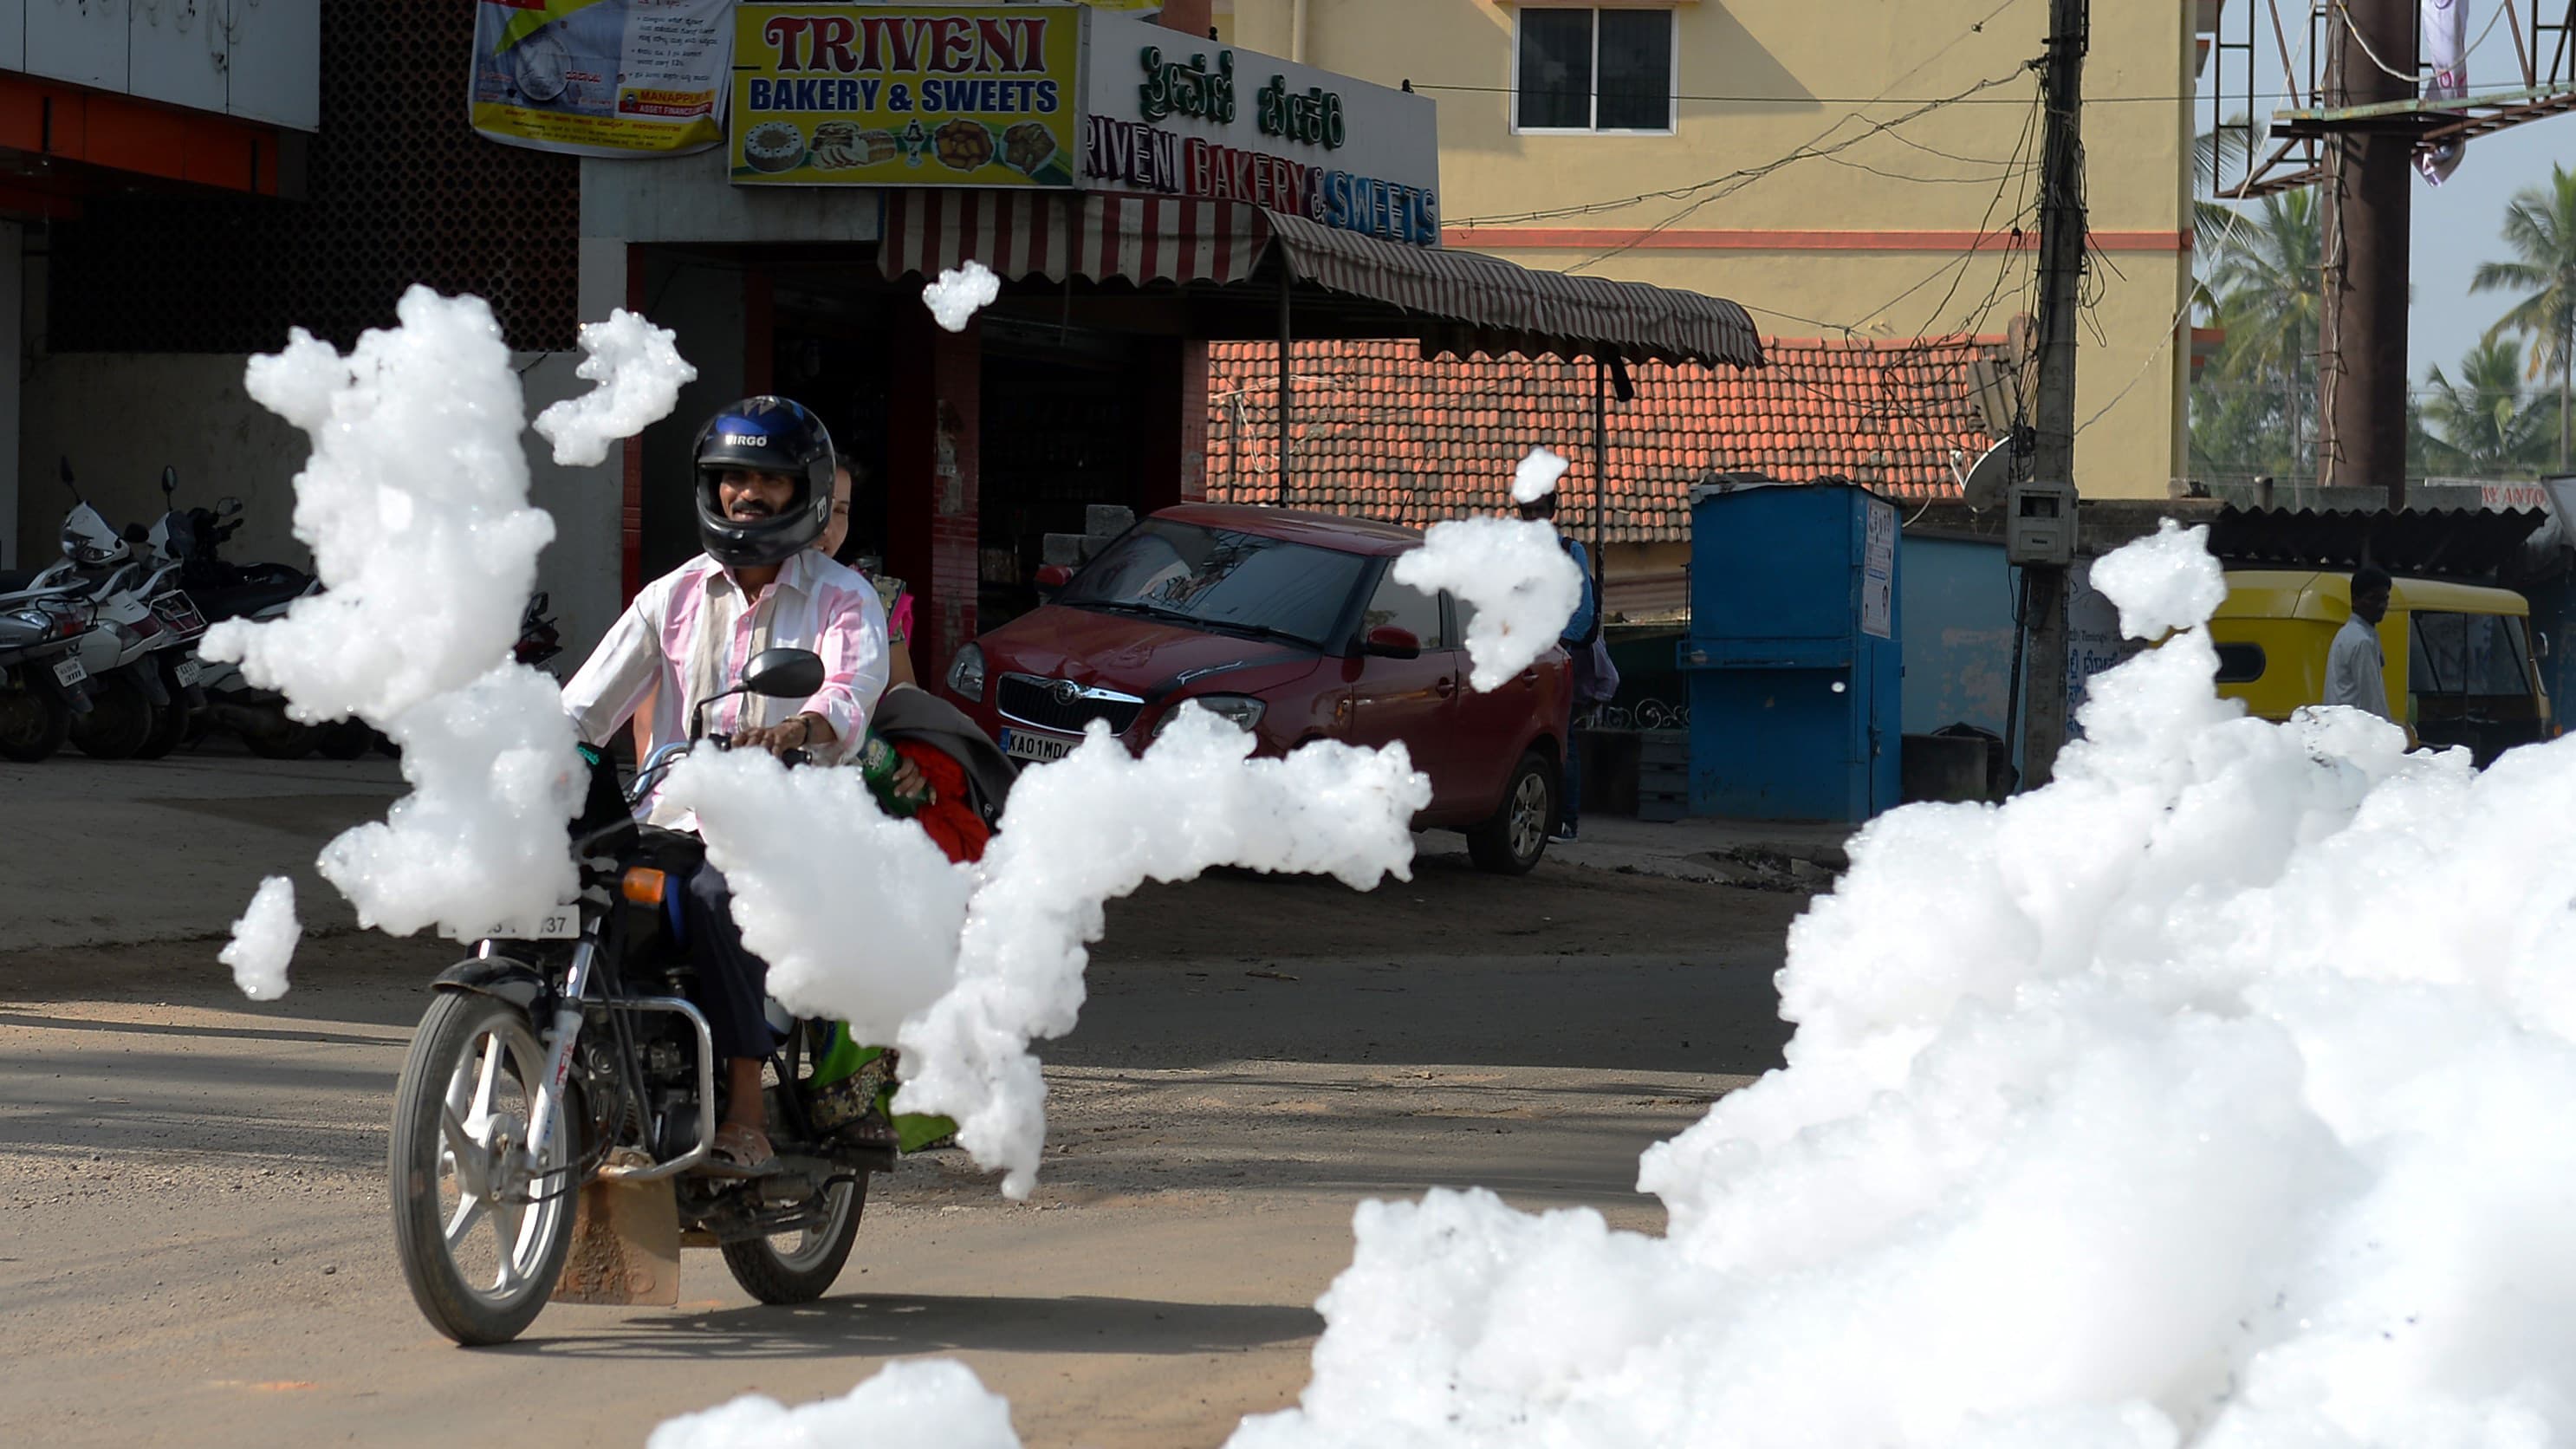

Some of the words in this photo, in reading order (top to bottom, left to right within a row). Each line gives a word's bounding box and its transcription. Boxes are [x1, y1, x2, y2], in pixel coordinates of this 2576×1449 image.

[764, 16, 1046, 73] TRIVENI
[749, 79, 880, 111] BAKERY
[888, 83, 913, 111] &
[922, 80, 1058, 113] SWEETS
[1086, 114, 1180, 193] RIVENI
[1184, 137, 1305, 216] BAKERY
[1303, 166, 1329, 224] &
[1326, 170, 1437, 246] SWEETS
[724, 434, 769, 447] VIRGO
